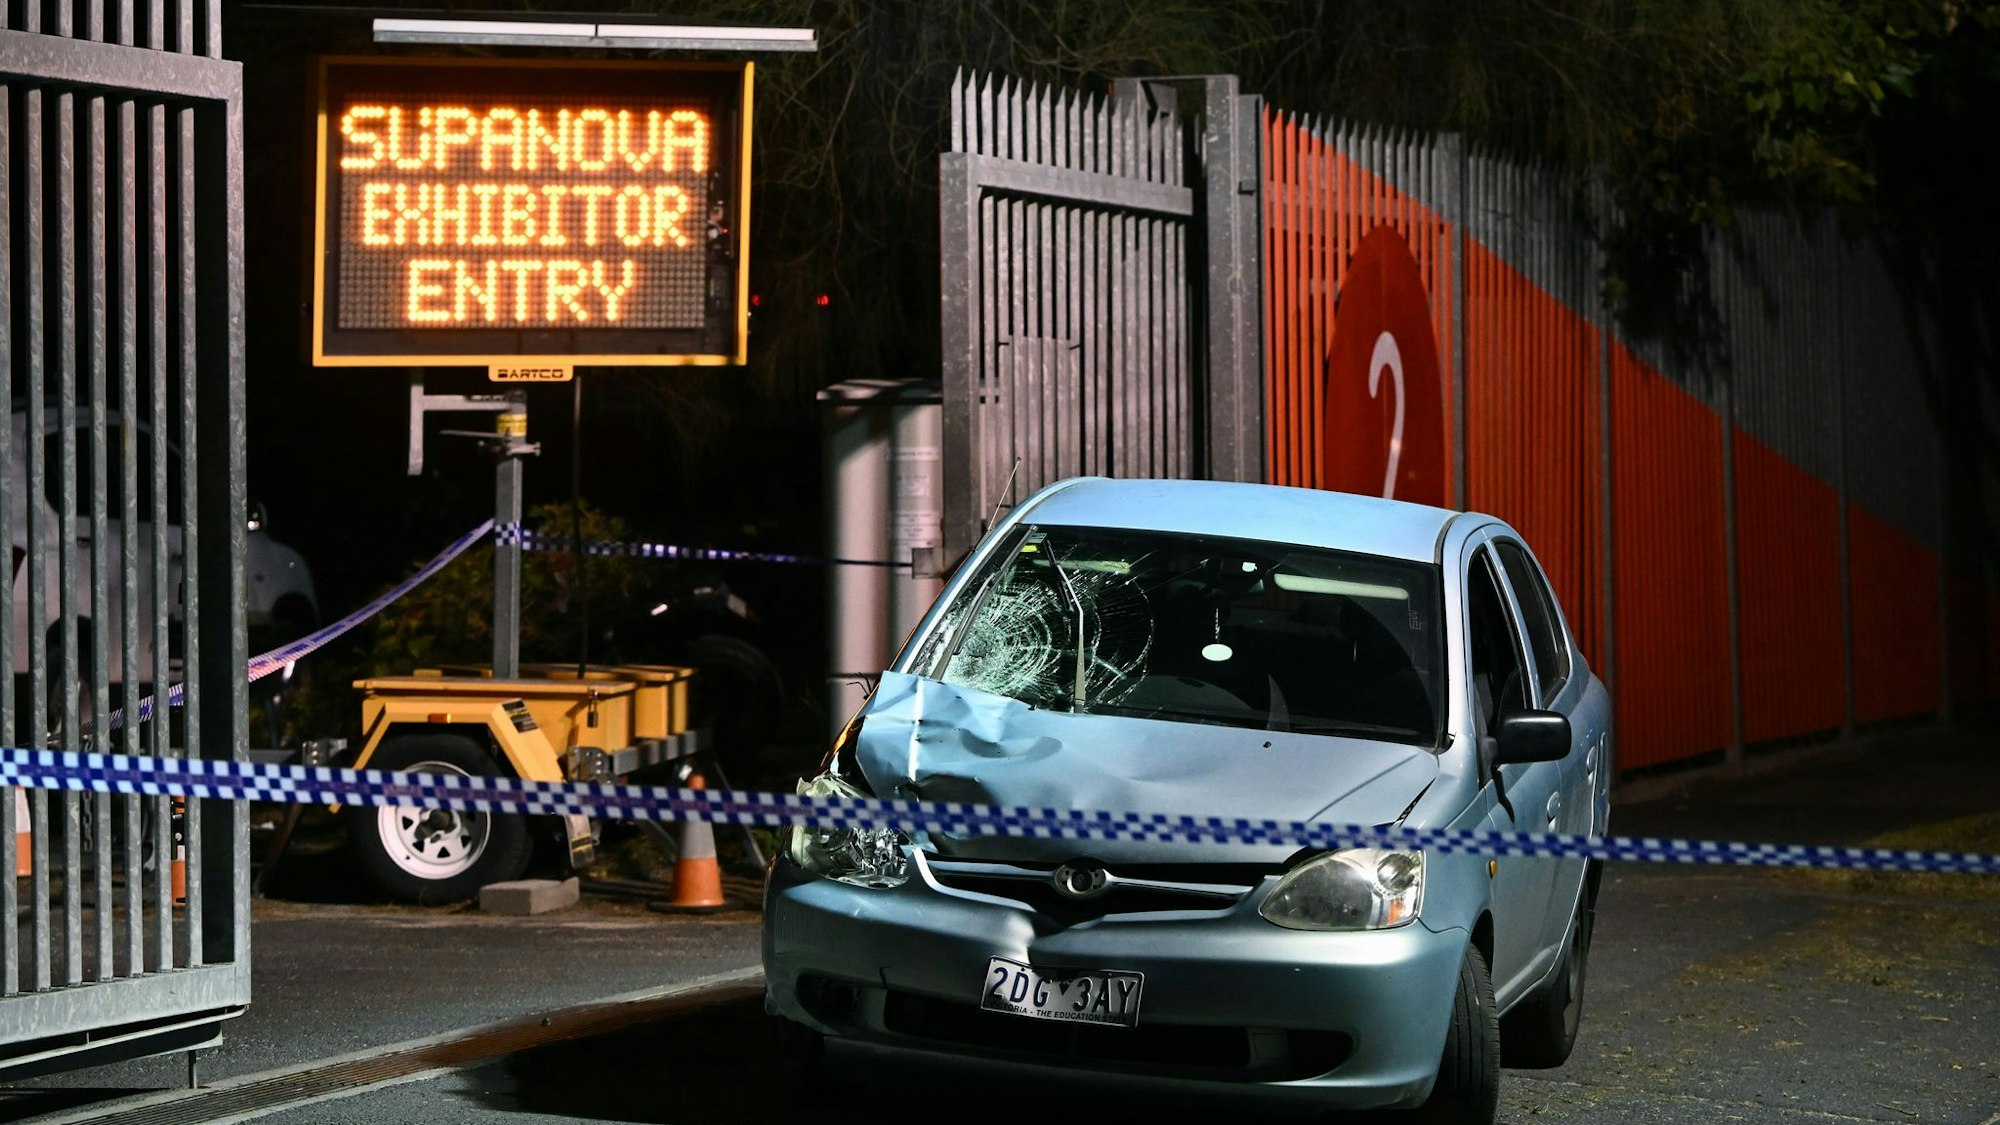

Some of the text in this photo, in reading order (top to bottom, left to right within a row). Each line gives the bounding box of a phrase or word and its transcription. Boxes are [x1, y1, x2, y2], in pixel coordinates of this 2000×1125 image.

[340, 105, 708, 172] SUPANOVA
[362, 183, 689, 247] EXHIBITOR
[407, 259, 634, 322] ENTRY
[990, 967, 1138, 1014] 2DG 3AY
[990, 1002, 1028, 1015] CTORIA
[1036, 1009, 1052, 1018] THE
[1053, 1011, 1101, 1022] EDUCATION
[1103, 1014, 1127, 1024] STAT
